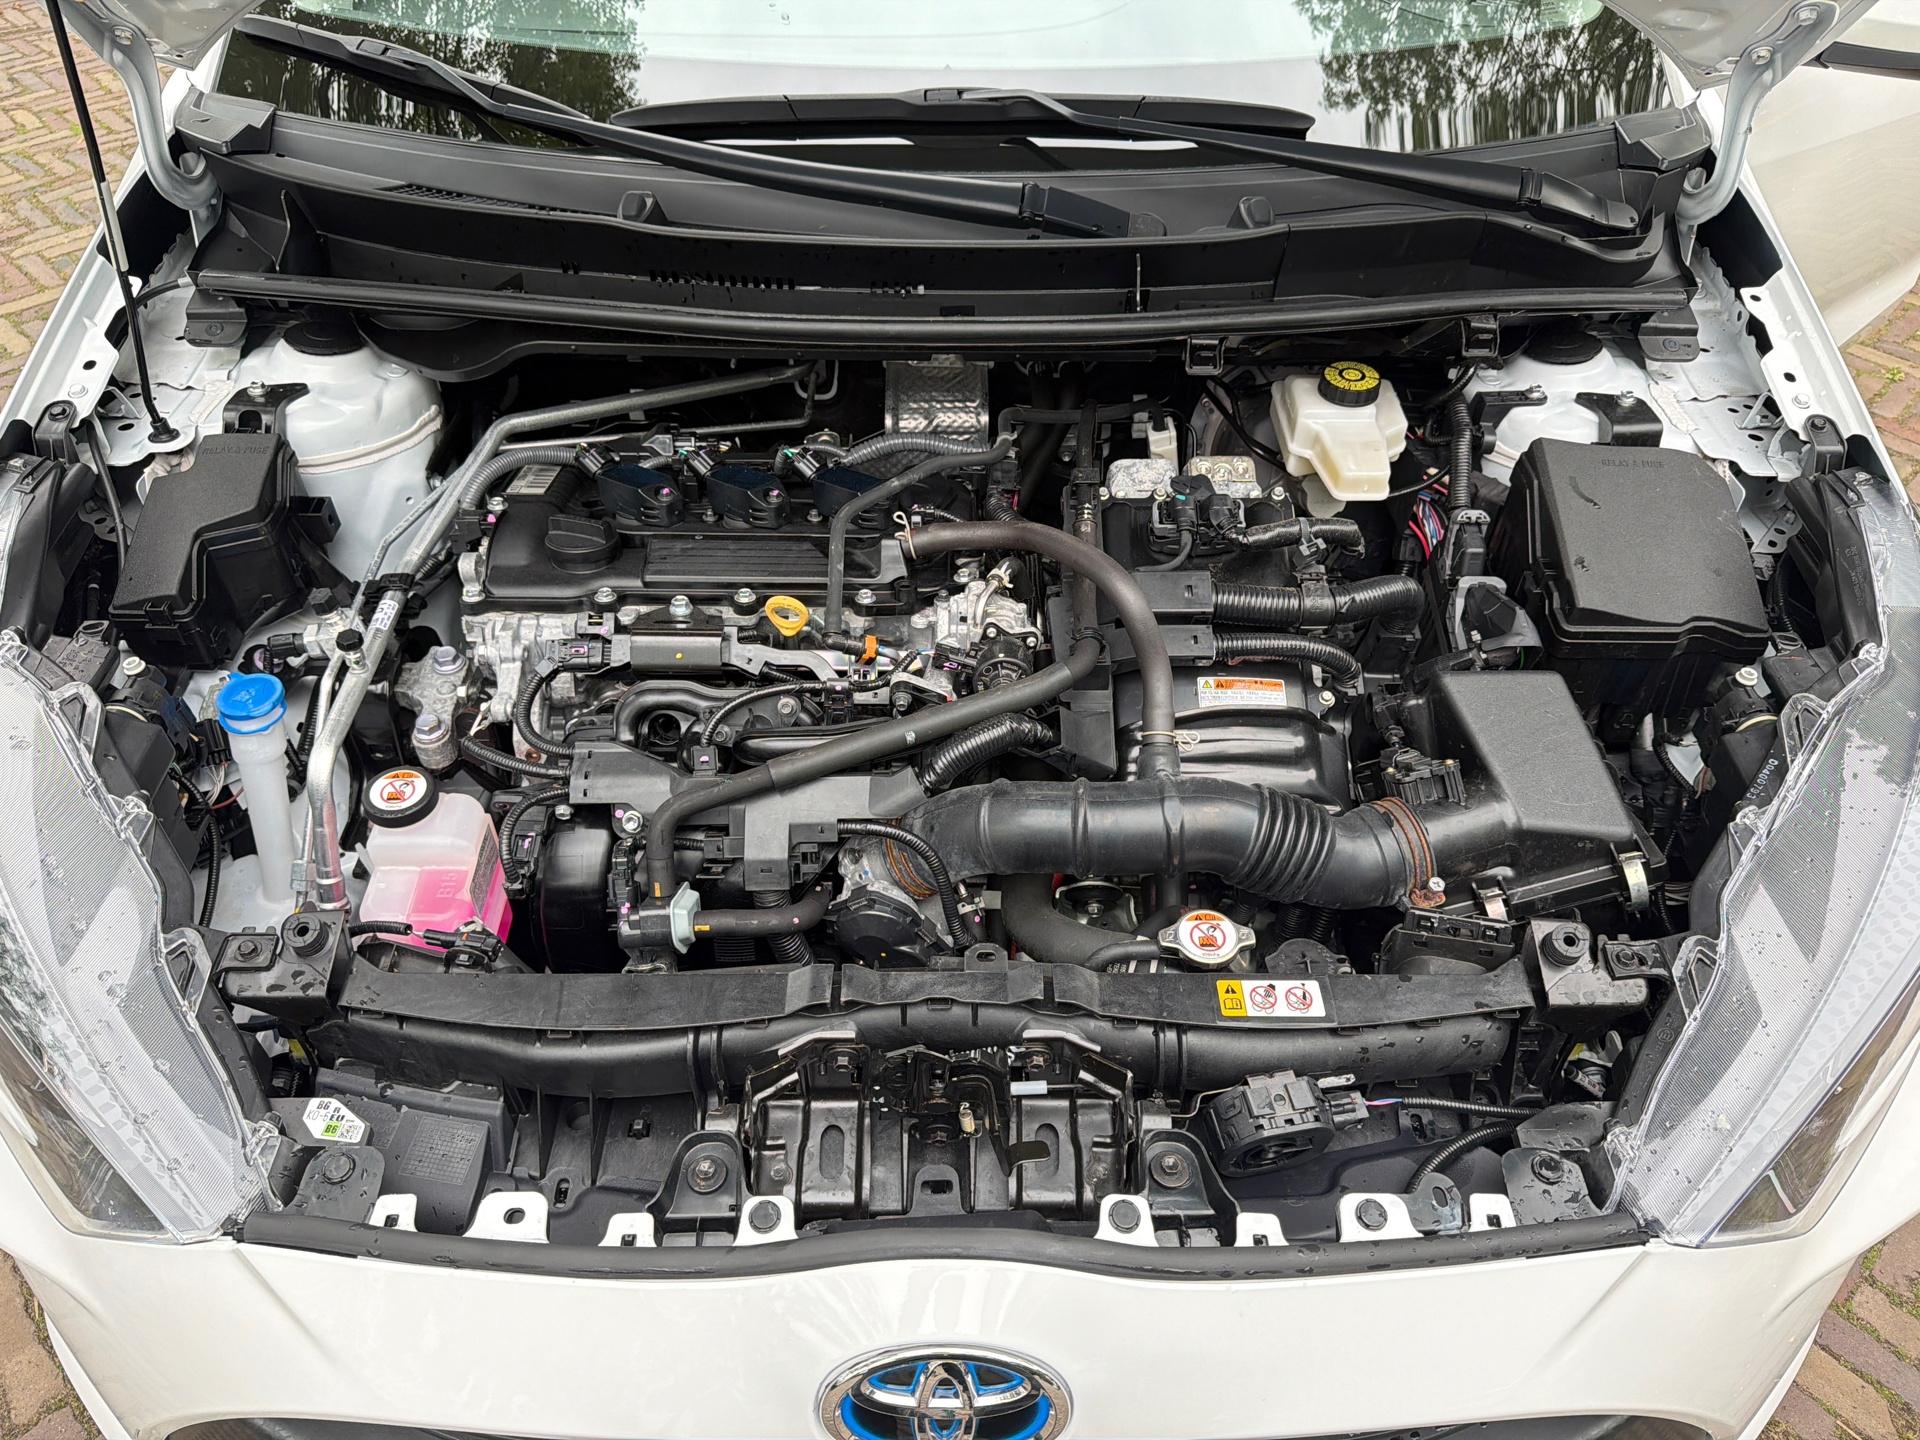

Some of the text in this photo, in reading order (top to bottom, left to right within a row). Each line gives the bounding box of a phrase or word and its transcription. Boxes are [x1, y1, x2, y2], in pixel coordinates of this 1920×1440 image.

[202, 446, 233, 455] RELAY
[244, 446, 270, 455] FUSE
[1601, 459, 1630, 468] RELAY
[1746, 758, 1779, 799] 00400793
[435, 872, 458, 898] B15
[329, 1114, 346, 1122] EU
